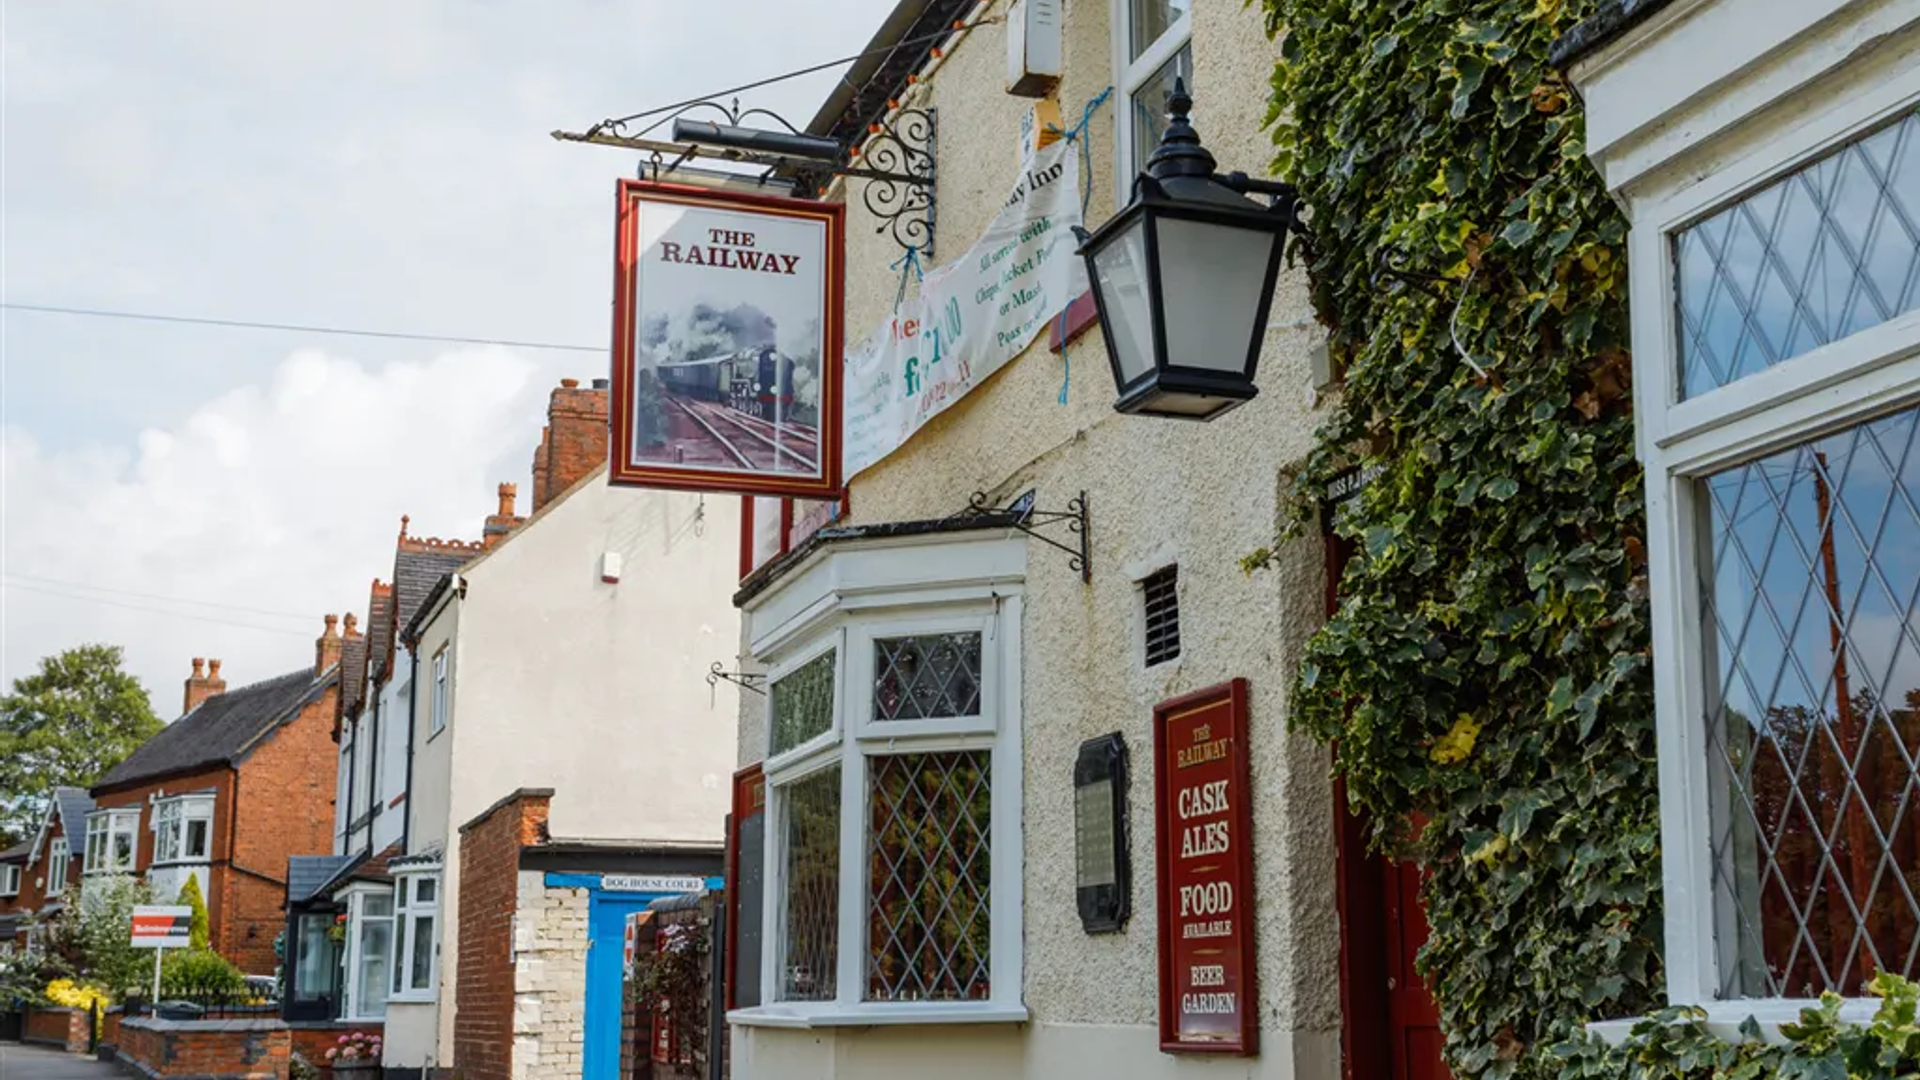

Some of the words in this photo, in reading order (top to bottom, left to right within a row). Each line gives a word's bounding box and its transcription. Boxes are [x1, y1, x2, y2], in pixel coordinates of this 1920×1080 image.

[1026, 162, 1064, 191] Inn
[709, 228, 755, 247] THE
[1020, 217, 1051, 244] with
[660, 241, 801, 275] RAILWAY
[1192, 723, 1210, 742] THE
[1177, 737, 1228, 769] RAILWAY
[1178, 779, 1230, 820] CASK
[1181, 820, 1230, 859] ALES
[605, 877, 629, 889] DOG
[630, 878, 661, 889] HOUSE
[665, 878, 699, 889] COURT
[1180, 881, 1233, 917] FOOD
[1182, 920, 1232, 939] AVAILABLE
[1190, 965, 1225, 987] BEER
[1182, 992, 1236, 1014] GARDEN
